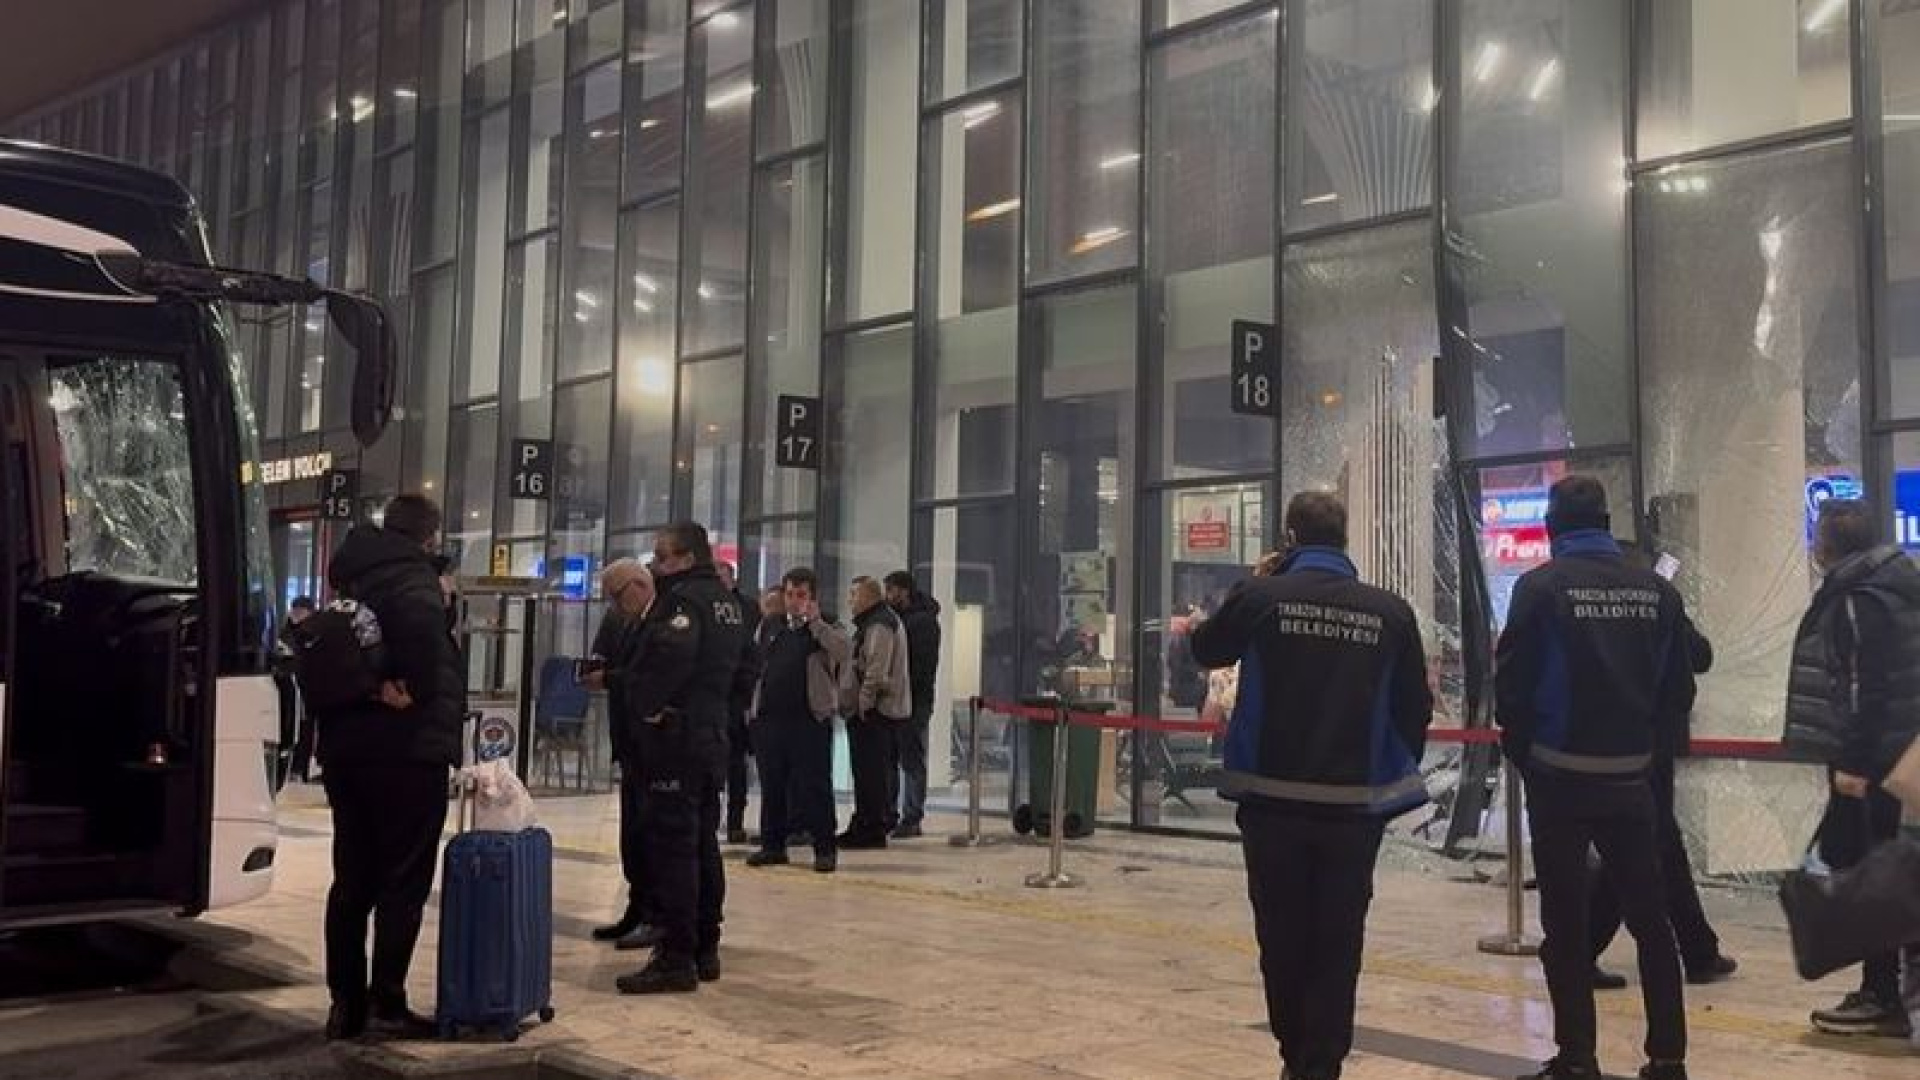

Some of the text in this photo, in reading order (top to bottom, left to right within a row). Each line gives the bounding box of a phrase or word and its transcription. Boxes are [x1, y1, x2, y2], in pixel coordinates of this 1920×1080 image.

[1245, 331, 1263, 363] P
[1237, 372, 1270, 407] 18
[789, 402, 807, 427] P
[522, 443, 539, 466] P
[781, 436, 813, 461] 17
[331, 474, 347, 493] P
[515, 472, 543, 495] 16
[325, 497, 349, 517] 15
[1278, 601, 1322, 619] TRABZON
